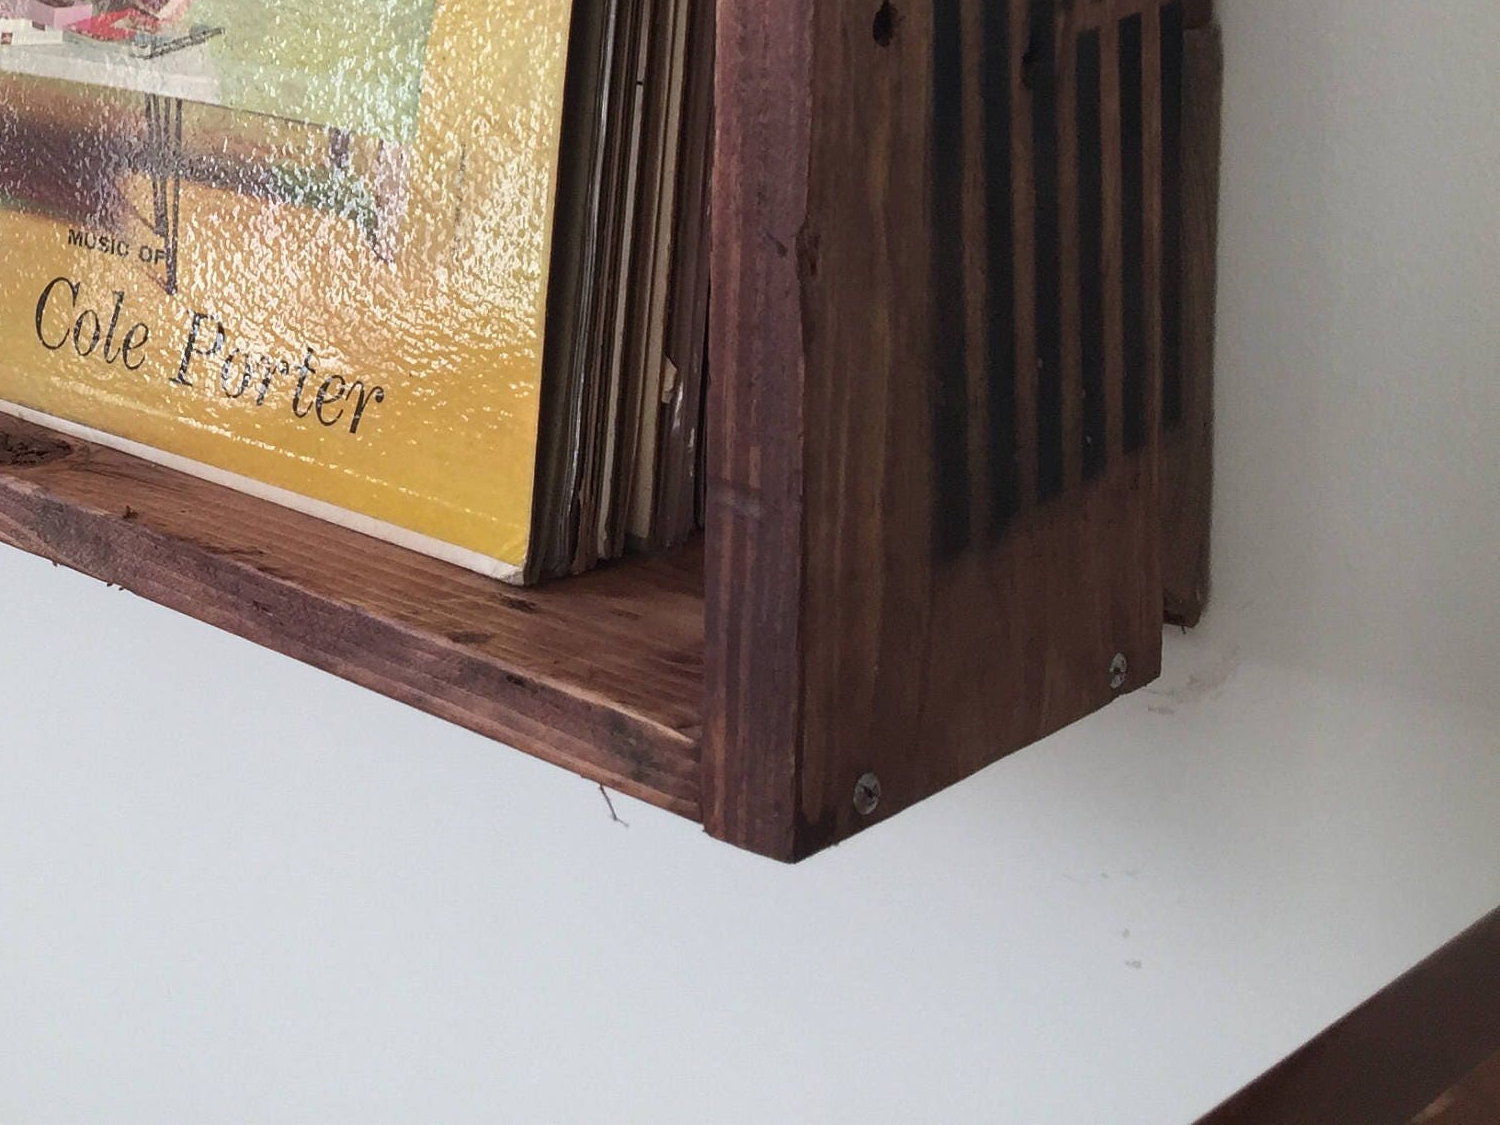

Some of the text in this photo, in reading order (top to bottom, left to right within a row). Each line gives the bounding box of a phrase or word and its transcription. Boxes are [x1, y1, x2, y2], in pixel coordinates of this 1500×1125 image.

[68, 229, 167, 265] MUSIC OF
[35, 276, 385, 434] Cole Porter
